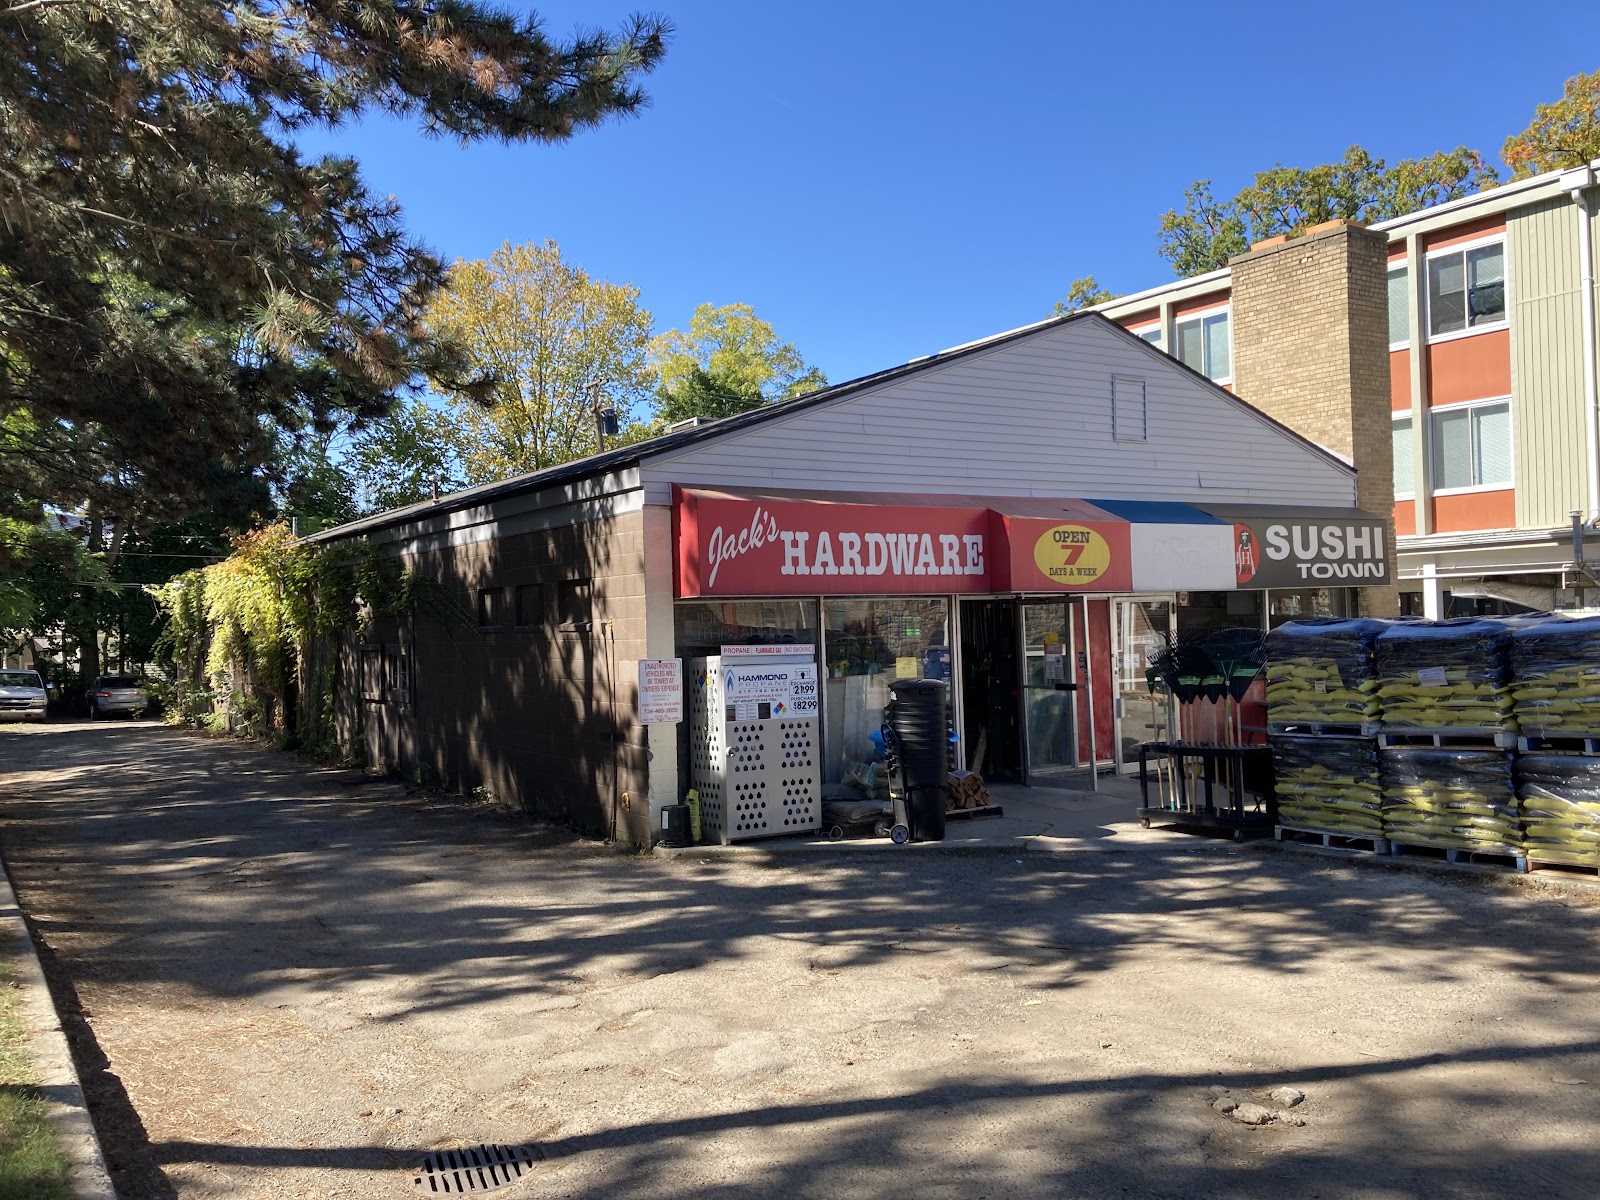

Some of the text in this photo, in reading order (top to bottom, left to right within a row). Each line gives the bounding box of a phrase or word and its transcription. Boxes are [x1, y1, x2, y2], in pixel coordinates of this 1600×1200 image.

[1053, 530, 1091, 543] OPEN
[1265, 524, 1384, 560] SUSHI
[708, 506, 985, 588] Jack's HARDWARE
[1060, 544, 1085, 565] 7
[1049, 567, 1097, 576] DAYS A WEEK
[1296, 562, 1385, 578] TOWN
[738, 673, 788, 682] HAMMOND
